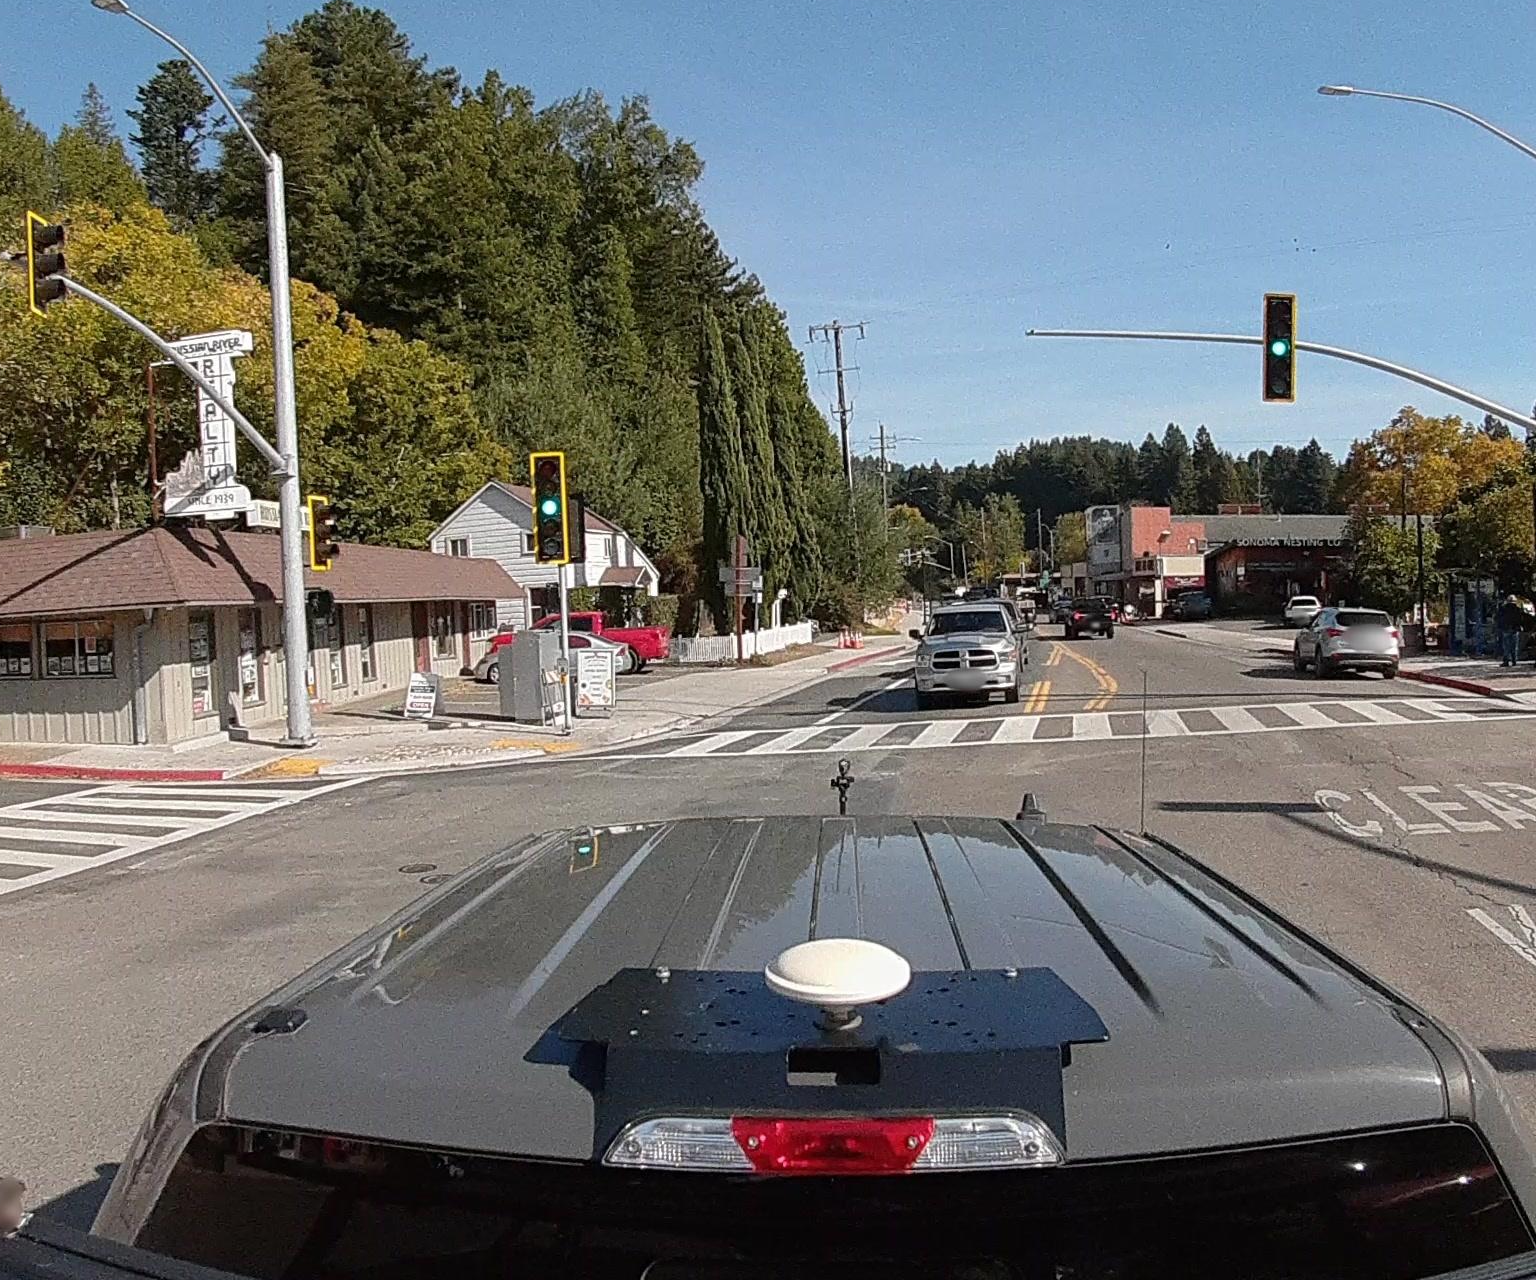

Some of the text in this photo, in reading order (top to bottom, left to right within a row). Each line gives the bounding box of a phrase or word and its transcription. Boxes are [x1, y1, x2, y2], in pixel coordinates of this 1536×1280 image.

[174, 338, 243, 356] USSIAN RIVER
[201, 358, 220, 486] RALTY
[1236, 538, 1281, 547] SONOMA
[1283, 538, 1324, 547] NESTING
